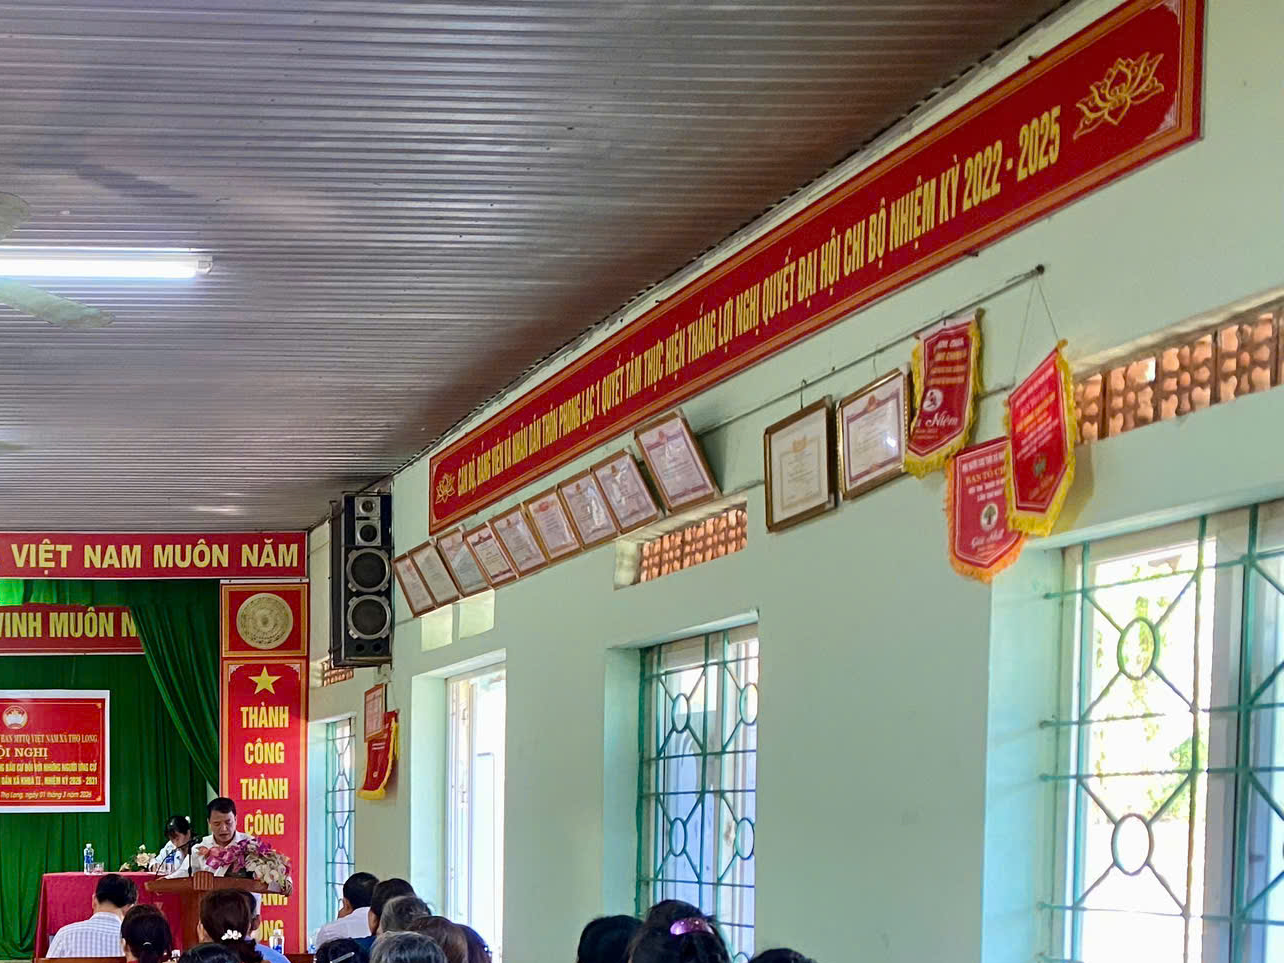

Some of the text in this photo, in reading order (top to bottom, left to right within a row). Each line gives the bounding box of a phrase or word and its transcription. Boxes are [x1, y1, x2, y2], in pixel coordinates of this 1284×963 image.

[559, 392, 581, 439] PHONG
[582, 384, 595, 431] LẠC
[602, 353, 624, 416] QUYẾT
[625, 351, 642, 400] TÂM
[644, 338, 664, 392] THỰC
[666, 323, 686, 380] HIỆN
[687, 302, 716, 364] THẮNG
[718, 296, 734, 353] LỢI
[735, 282, 760, 336] NGHỊ
[762, 247, 796, 326] QUYẾT
[797, 248, 818, 308] ĐẠI
[820, 227, 841, 296] HỘI
[843, 218, 866, 276] CHI
[868, 197, 887, 269] BỘ
[889, 175, 937, 252] NHIỆM
[939, 154, 961, 225] KỲ
[963, 139, 1003, 213] 2022
[1017, 104, 1061, 182] 2025
[11, 538, 73, 575] VIỆT
[83, 544, 142, 569] NAM
[153, 539, 229, 568] MUÔN
[241, 538, 299, 568] NĂM
[49, 607, 114, 638] MUÔN
[240, 701, 289, 728] THÀNH
[82, 734, 97, 743] LONG
[244, 737, 285, 764] CÔNG
[14, 747, 48, 760] NGHỊ
[240, 773, 289, 800] THÀNH
[244, 809, 284, 836] CÔNG
